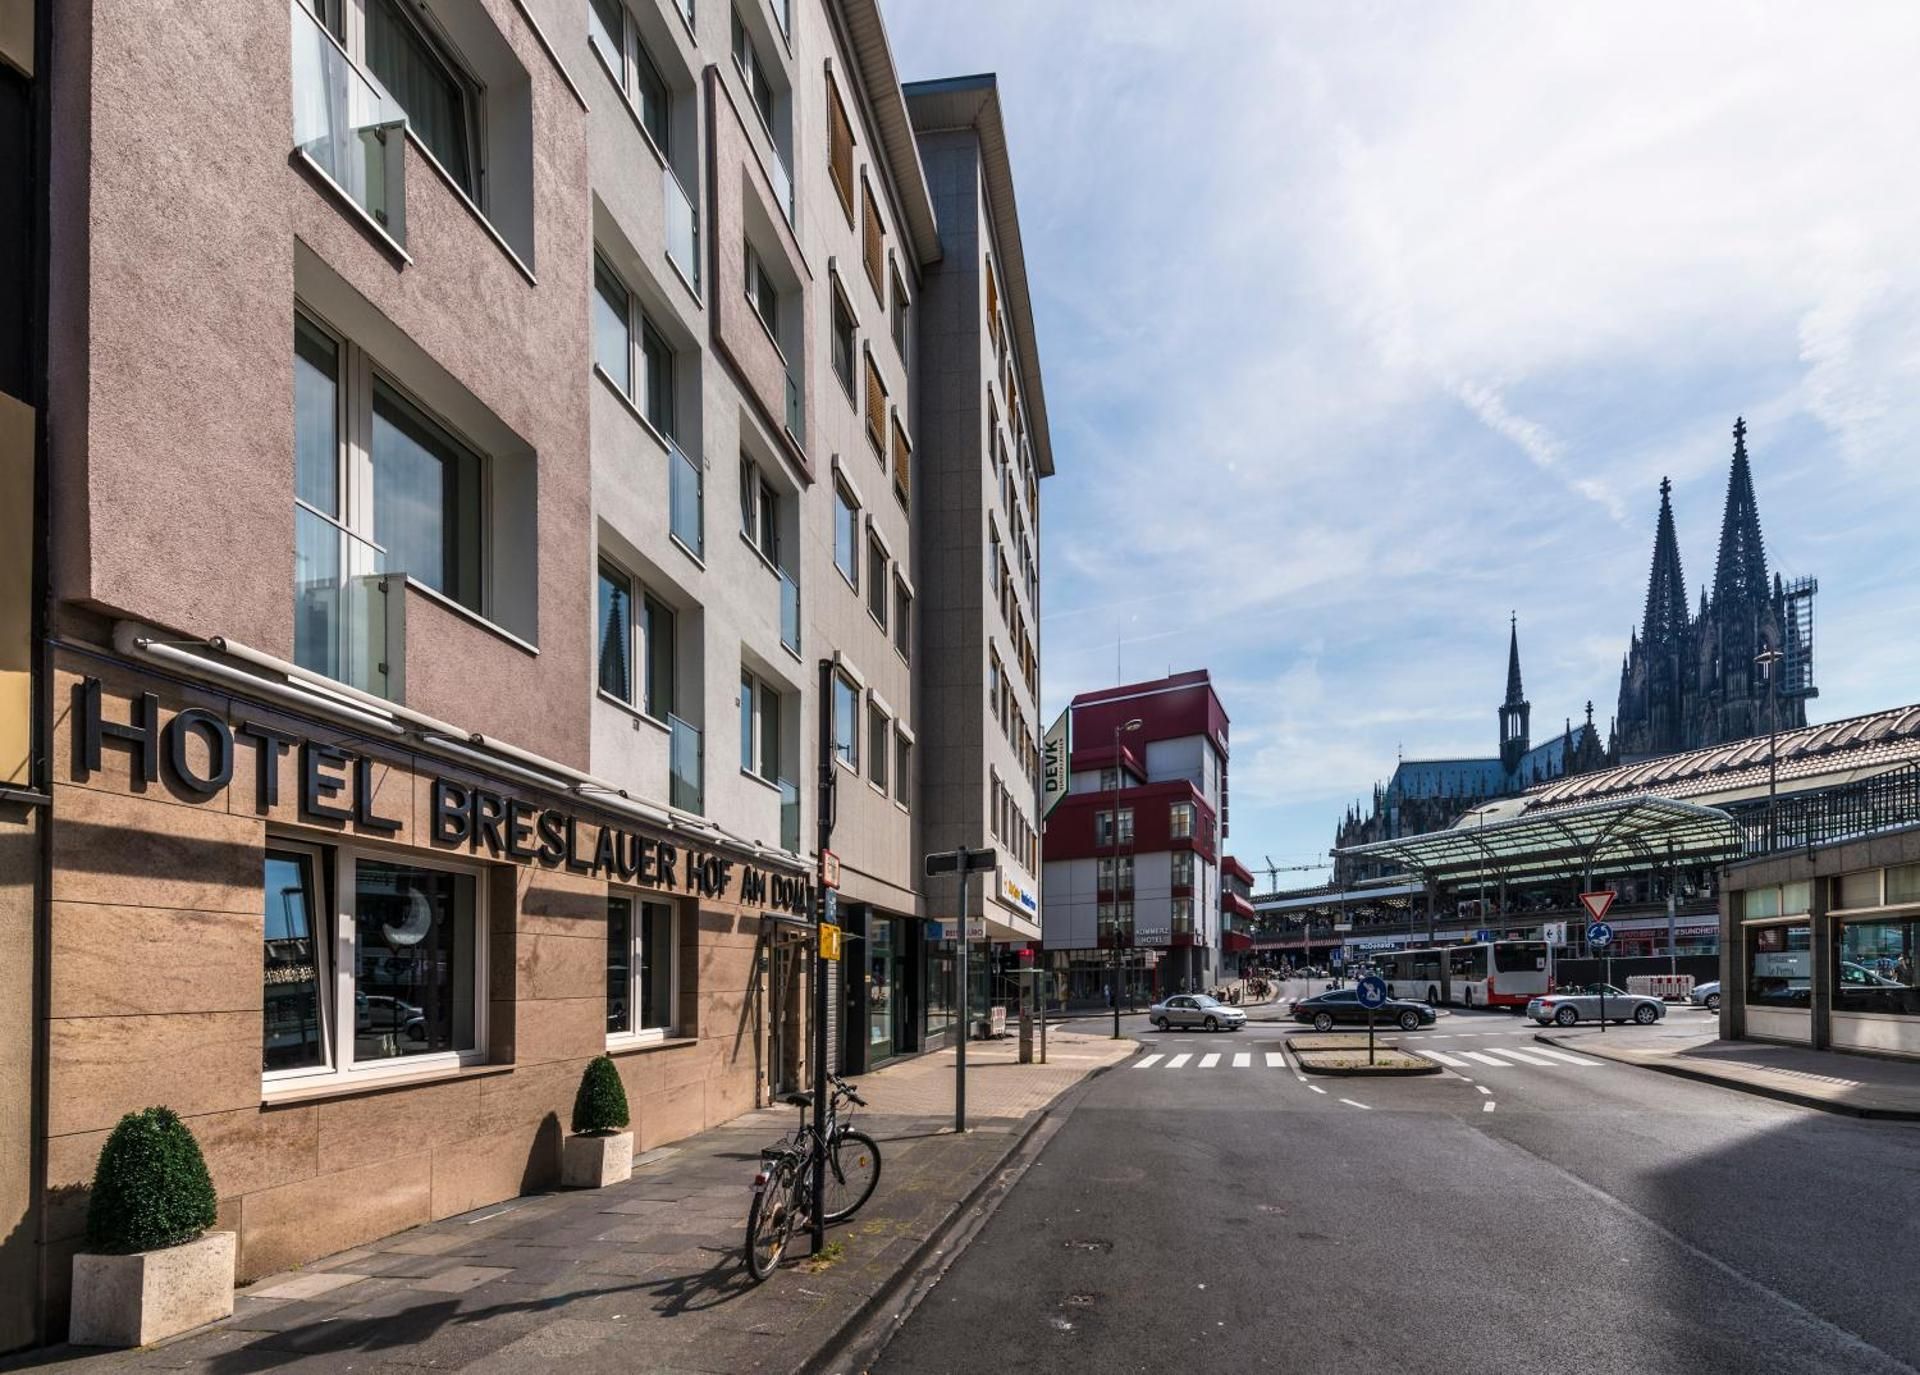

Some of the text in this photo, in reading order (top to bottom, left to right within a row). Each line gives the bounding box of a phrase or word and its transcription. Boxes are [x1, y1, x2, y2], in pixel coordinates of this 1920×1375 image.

[84, 675, 403, 832] HOTEL
[434, 776, 677, 888] BRESLAUER
[687, 850, 734, 899] HOF
[741, 865, 767, 908] AM
[1045, 740, 1058, 792] DEVK
[1136, 927, 1169, 935] KOMMERZ
